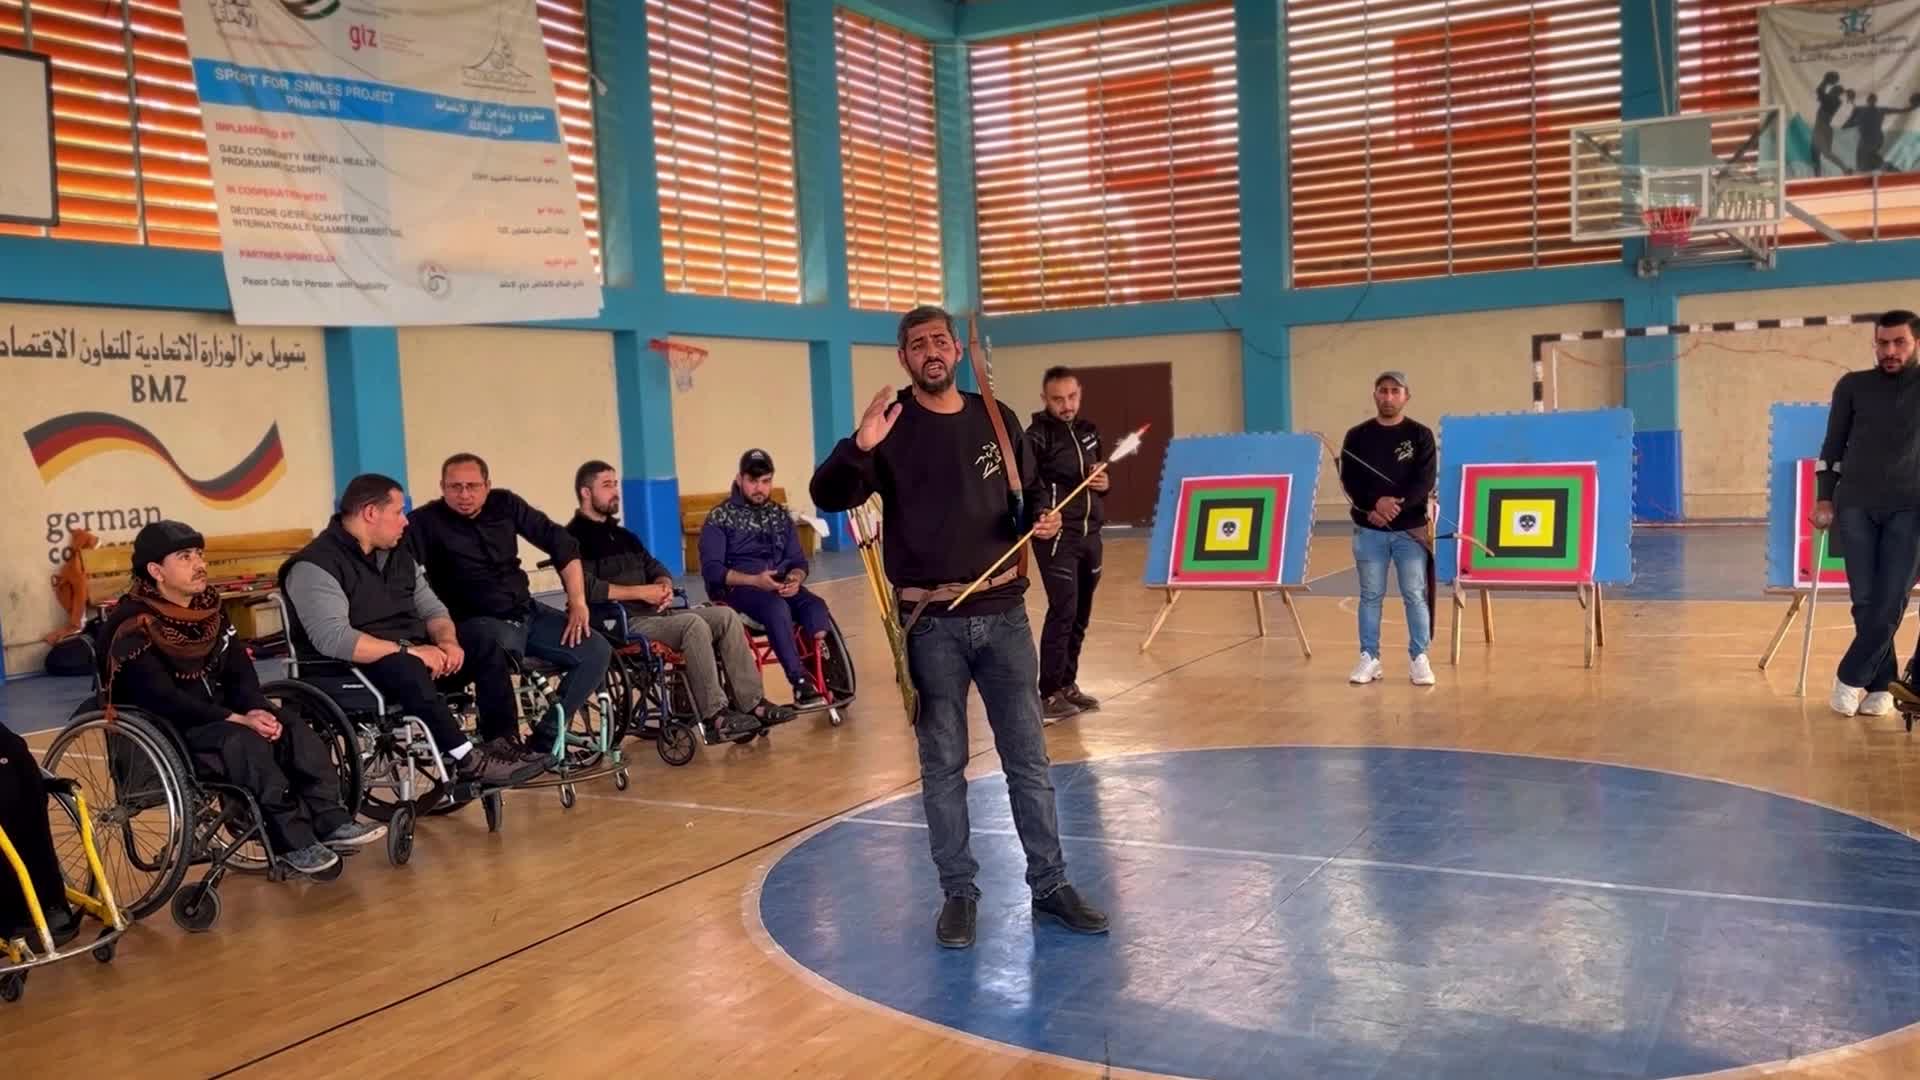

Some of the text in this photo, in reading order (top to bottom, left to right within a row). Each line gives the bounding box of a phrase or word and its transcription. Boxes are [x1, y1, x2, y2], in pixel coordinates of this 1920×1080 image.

[349, 25, 377, 50] giz
[214, 67, 394, 104] SPORT FOR SMILES PROJECT
[218, 144, 245, 155] GAZA
[342, 157, 377, 169] HEALTH
[241, 276, 268, 287] Peace
[271, 277, 290, 288] Club
[304, 279, 334, 289] Person
[80, 328, 132, 366] للتعاون
[136, 332, 198, 368] الاتحادية
[201, 332, 243, 368] الوزارة
[245, 341, 264, 367] من
[266, 336, 308, 371] بتمويل
[130, 373, 188, 404] BMZ
[46, 505, 161, 544] german
